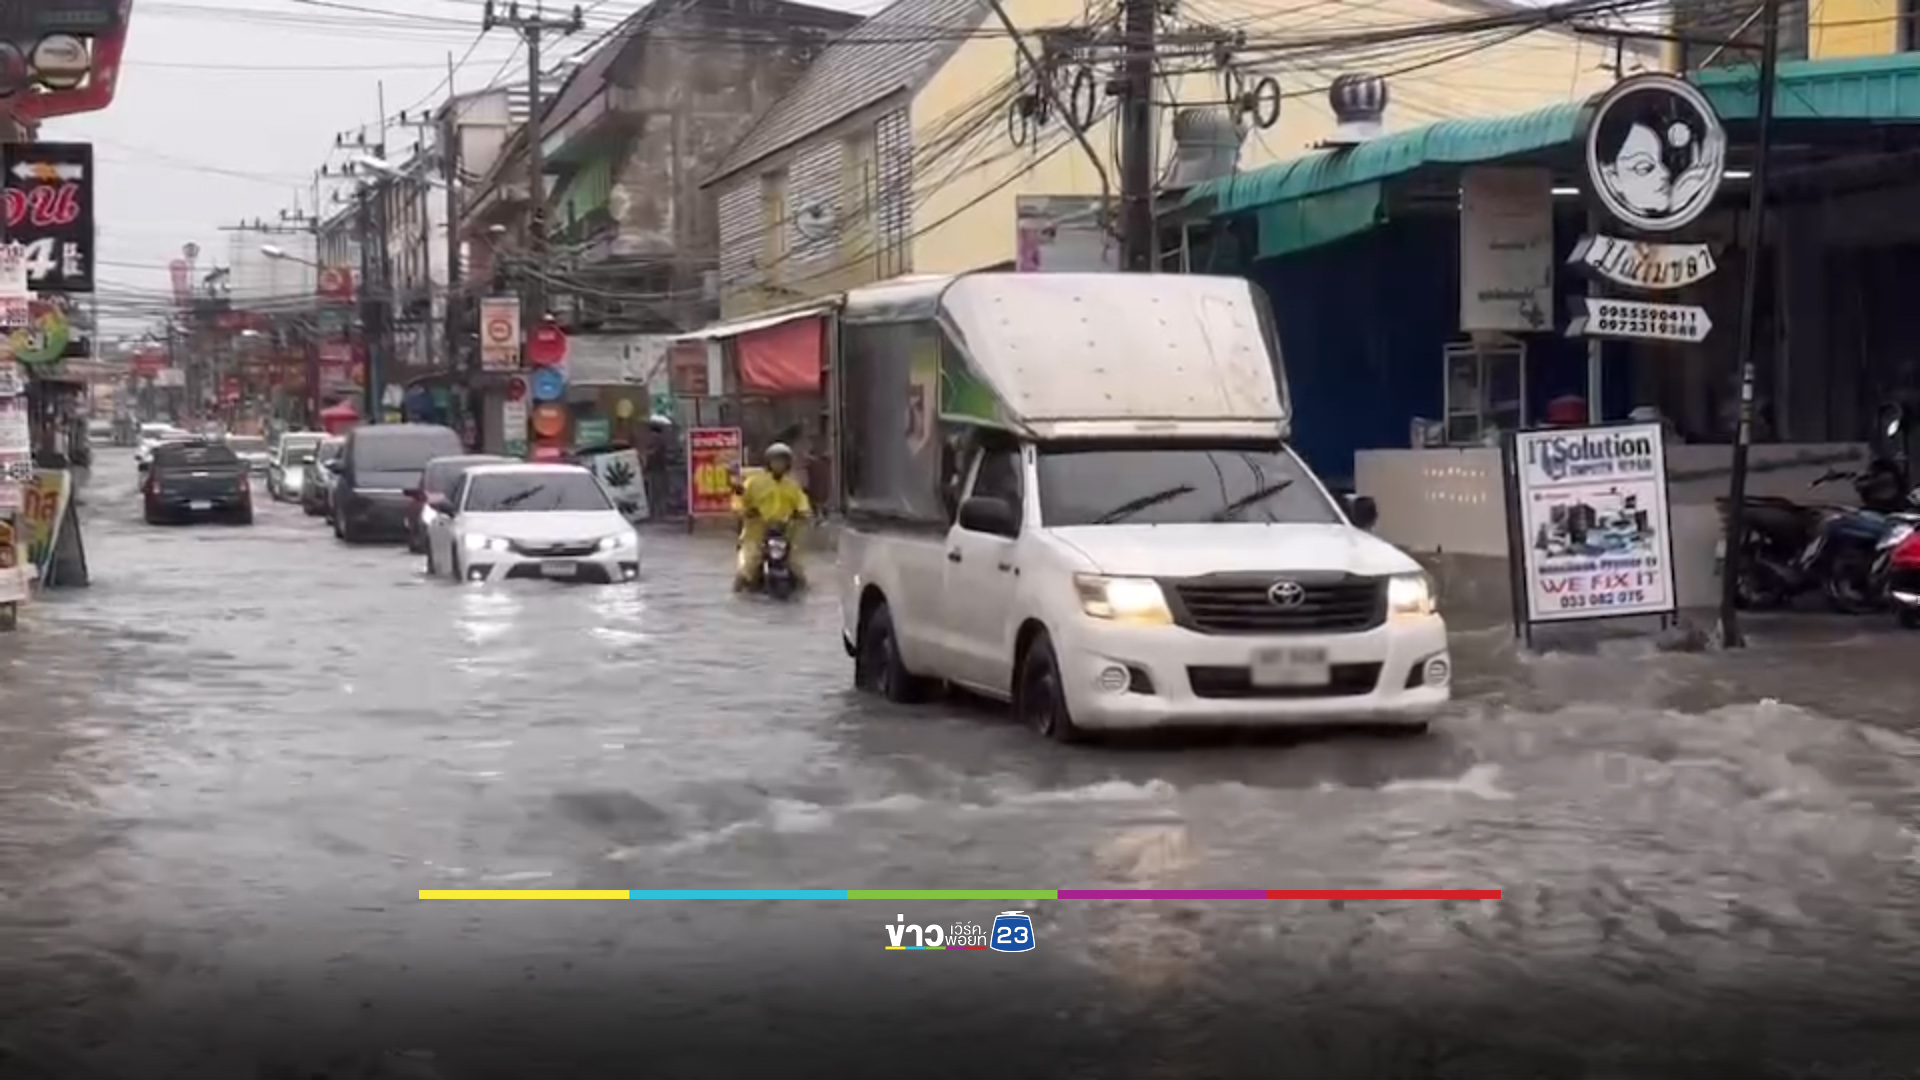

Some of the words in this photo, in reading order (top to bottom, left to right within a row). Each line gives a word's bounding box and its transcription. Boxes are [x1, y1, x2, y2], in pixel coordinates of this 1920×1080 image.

[1540, 576, 1586, 593] WE
[1591, 572, 1630, 590] FIX
[1636, 569, 1658, 586] IT
